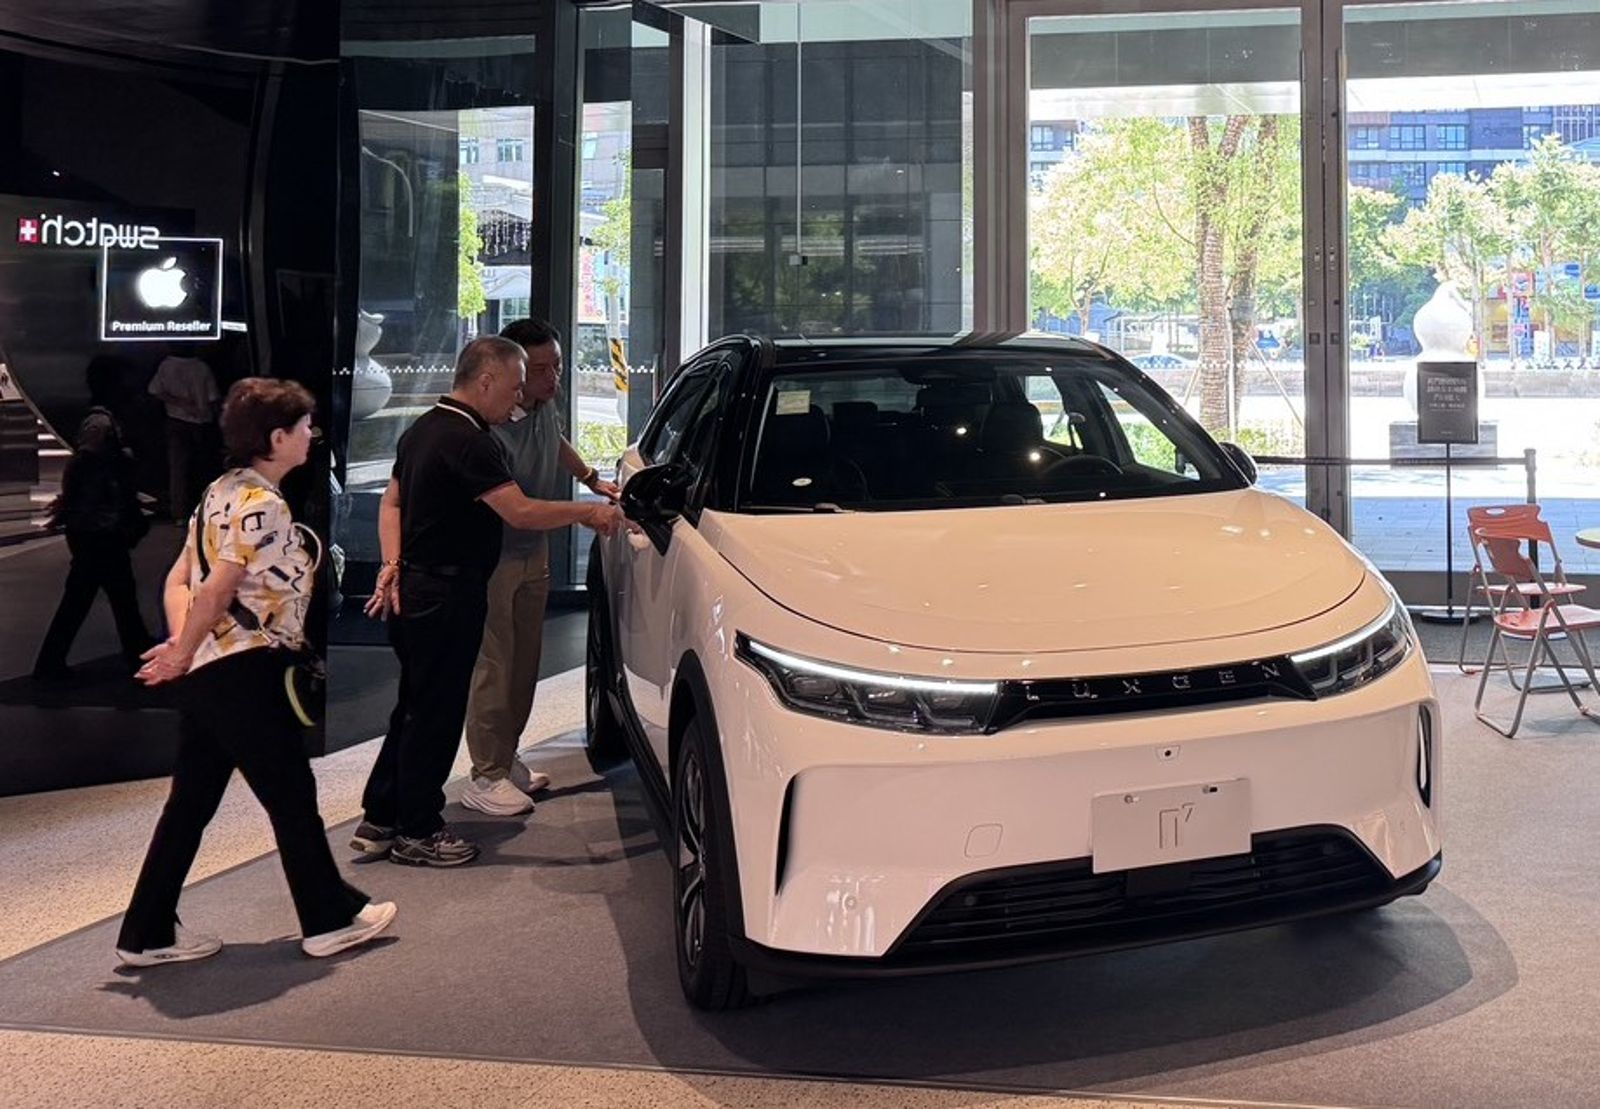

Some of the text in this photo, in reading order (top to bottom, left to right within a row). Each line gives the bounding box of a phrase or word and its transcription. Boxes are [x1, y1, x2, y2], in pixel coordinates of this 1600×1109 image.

[112, 320, 211, 332] Premium Reseller
[1025, 662, 1281, 701] LUXGEN
